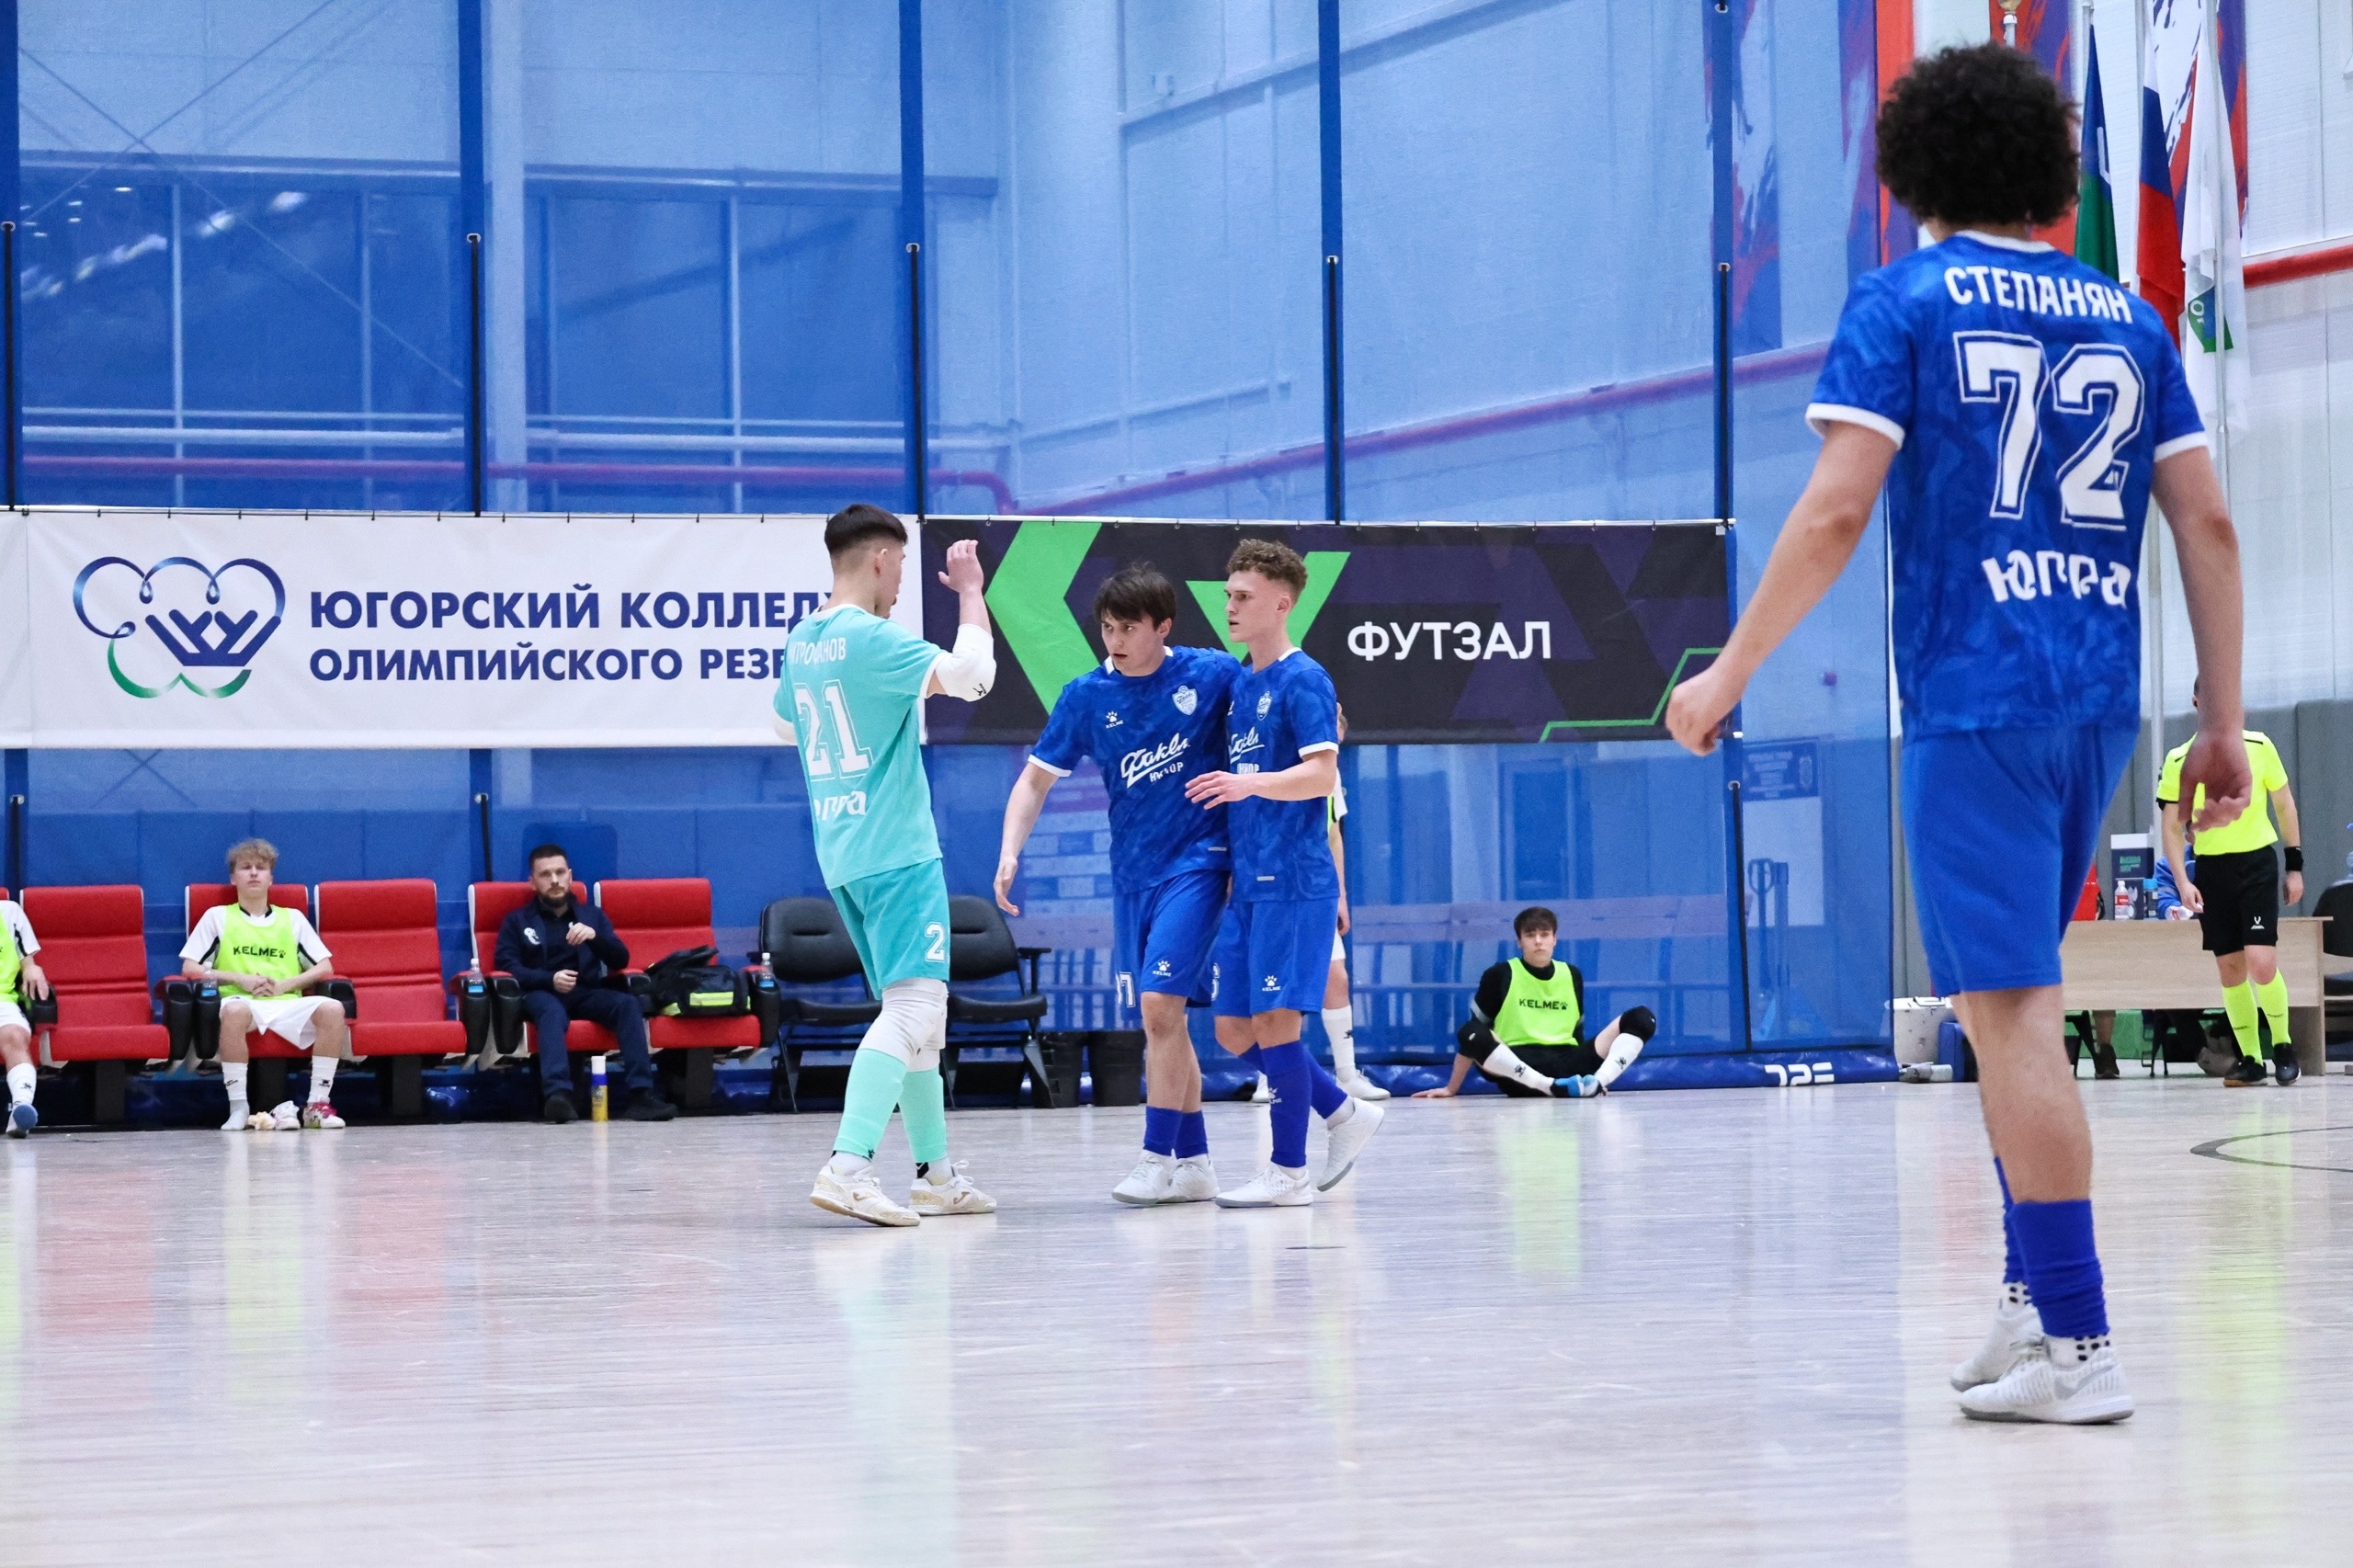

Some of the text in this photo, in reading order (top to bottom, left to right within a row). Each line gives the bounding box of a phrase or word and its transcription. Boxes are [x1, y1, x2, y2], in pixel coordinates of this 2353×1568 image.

[1944, 265, 2133, 324] СТЕПАНЯН
[1953, 330, 2145, 531] 72
[1981, 549, 2131, 609] Югра
[311, 583, 832, 634] ЮГОРСКИЙ КОЛЛЕД
[309, 641, 683, 682] ОЛИМПИЙСКОГО
[1347, 620, 1552, 662] ФУТЗАЛ
[793, 679, 874, 782] 21
[233, 946, 278, 958] KELME
[925, 921, 950, 963] 2
[1518, 998, 1561, 1010] KELME
